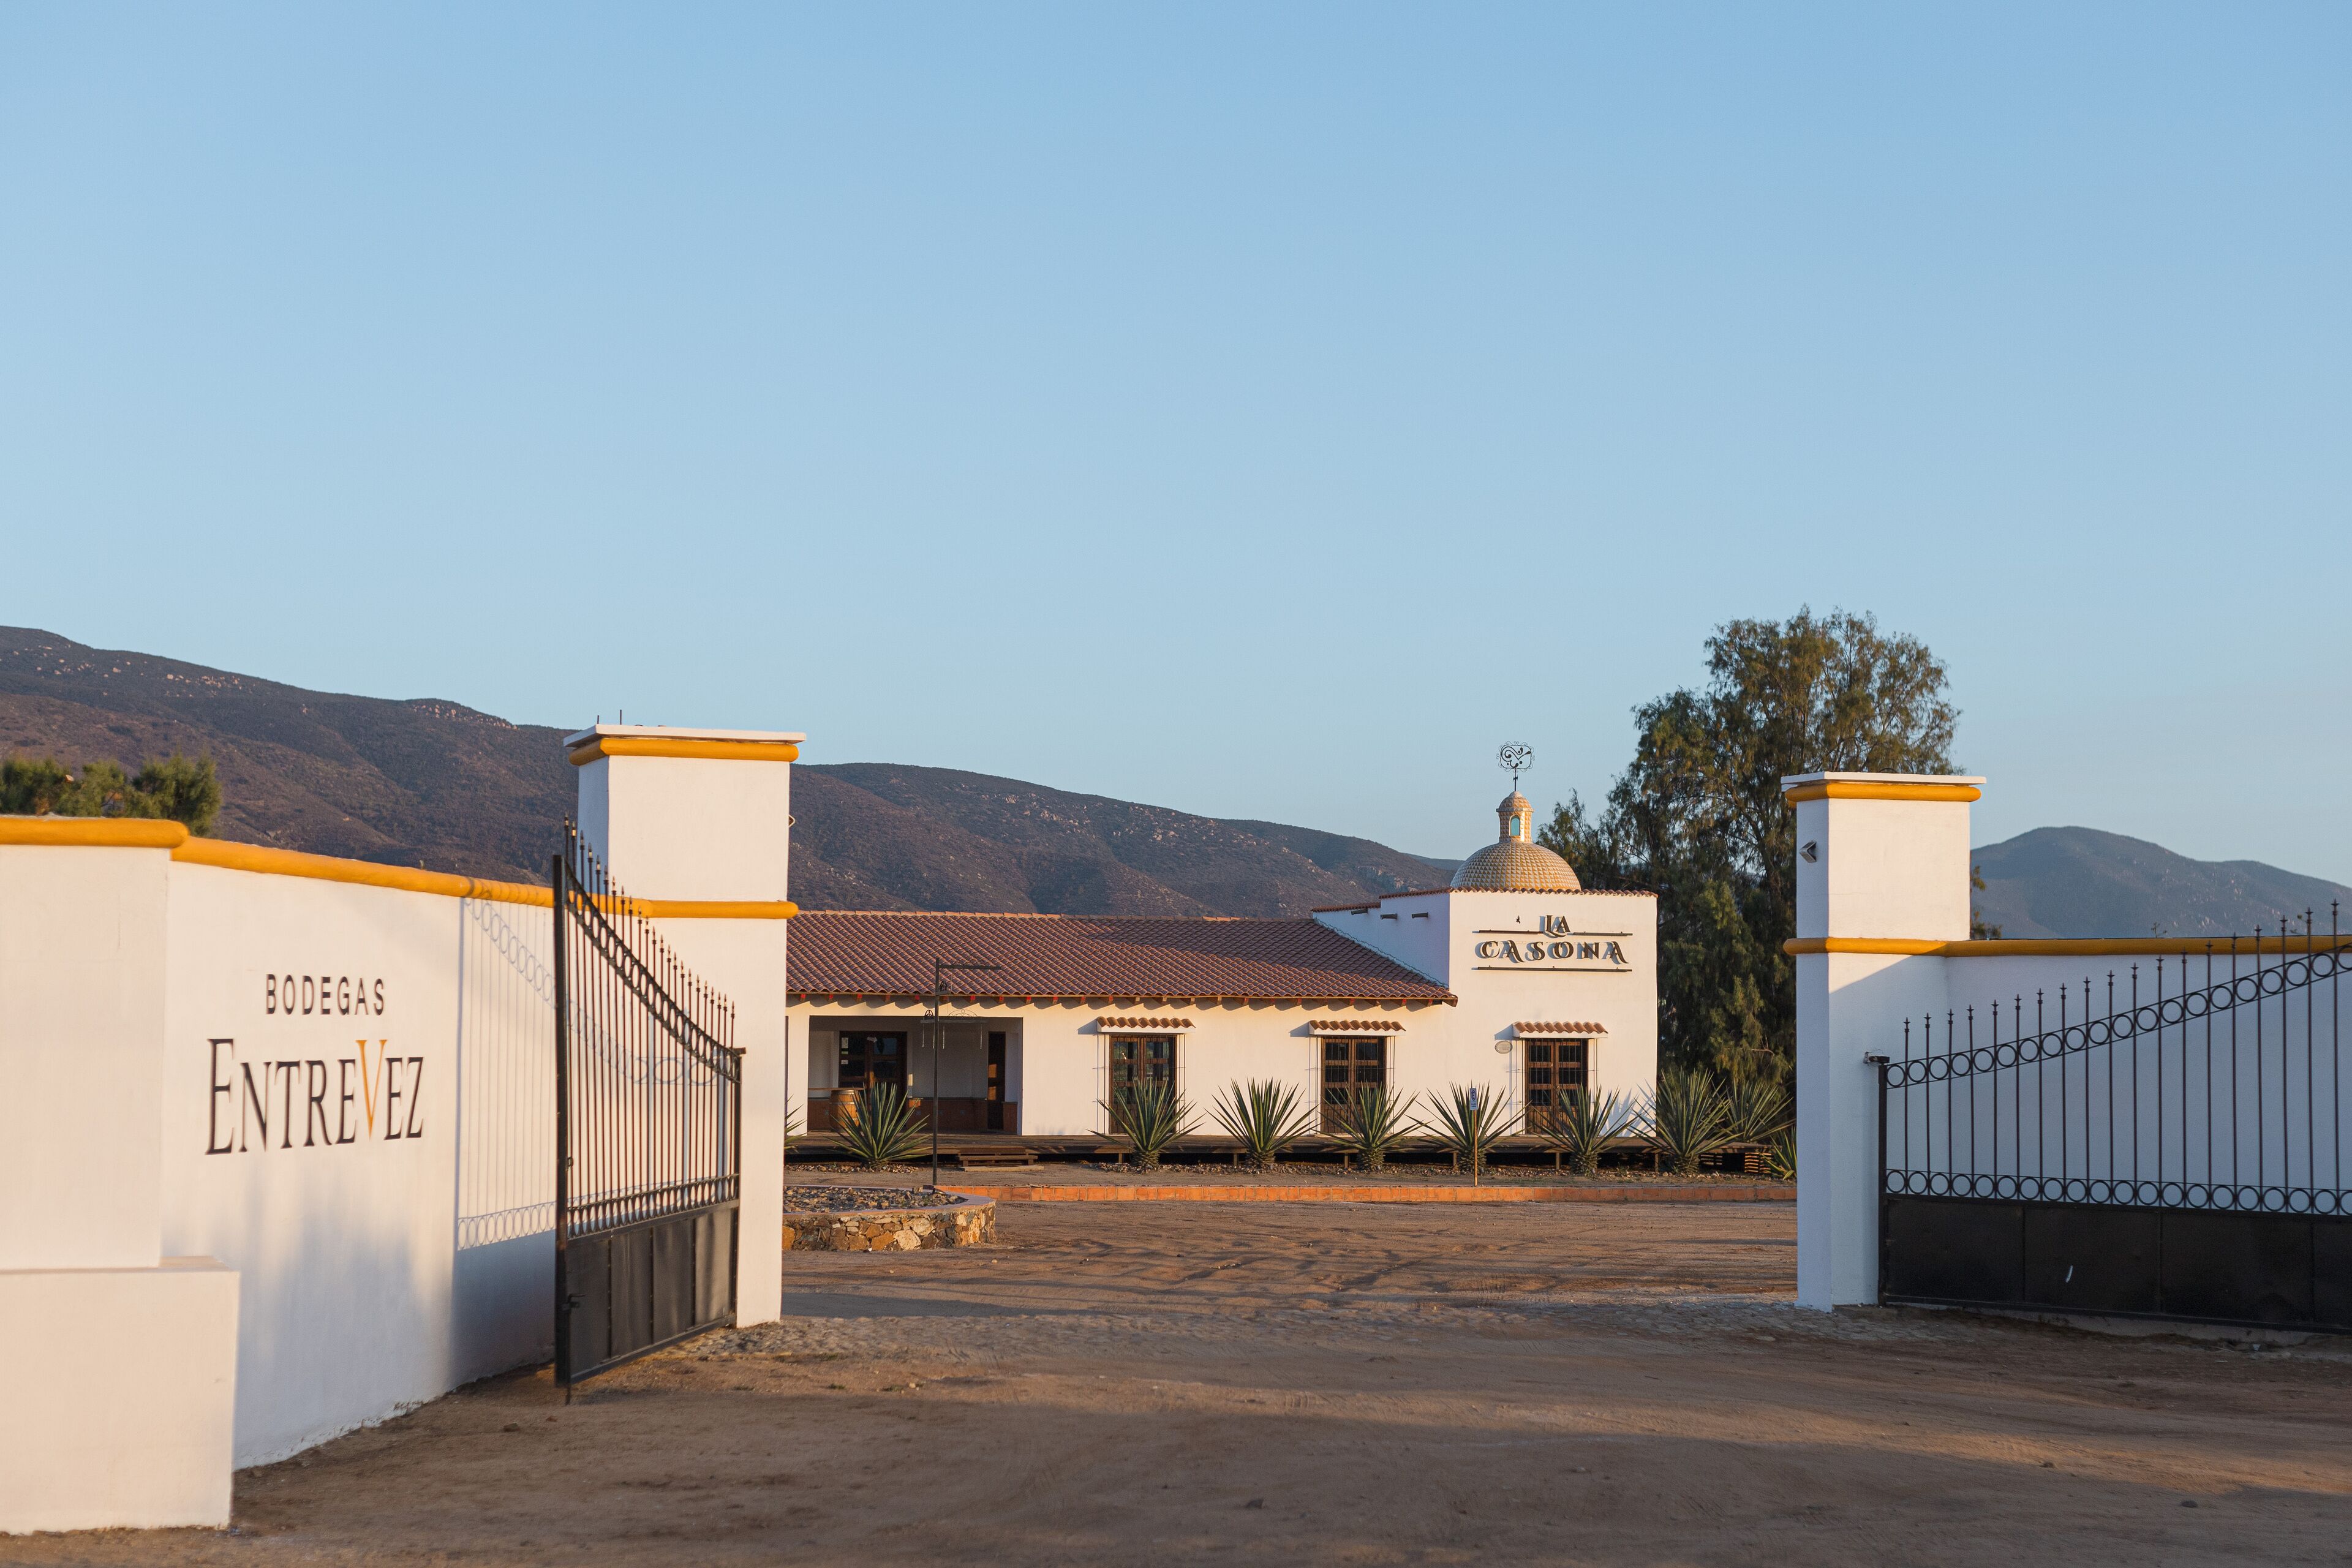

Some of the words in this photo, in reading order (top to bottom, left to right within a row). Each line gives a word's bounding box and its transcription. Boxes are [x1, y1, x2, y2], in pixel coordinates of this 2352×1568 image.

[1545, 914, 1571, 938] LA
[1482, 940, 1629, 964] CASONA
[266, 973, 385, 1016] BODEGAS
[205, 1038, 424, 1155] ENTREVEZ
